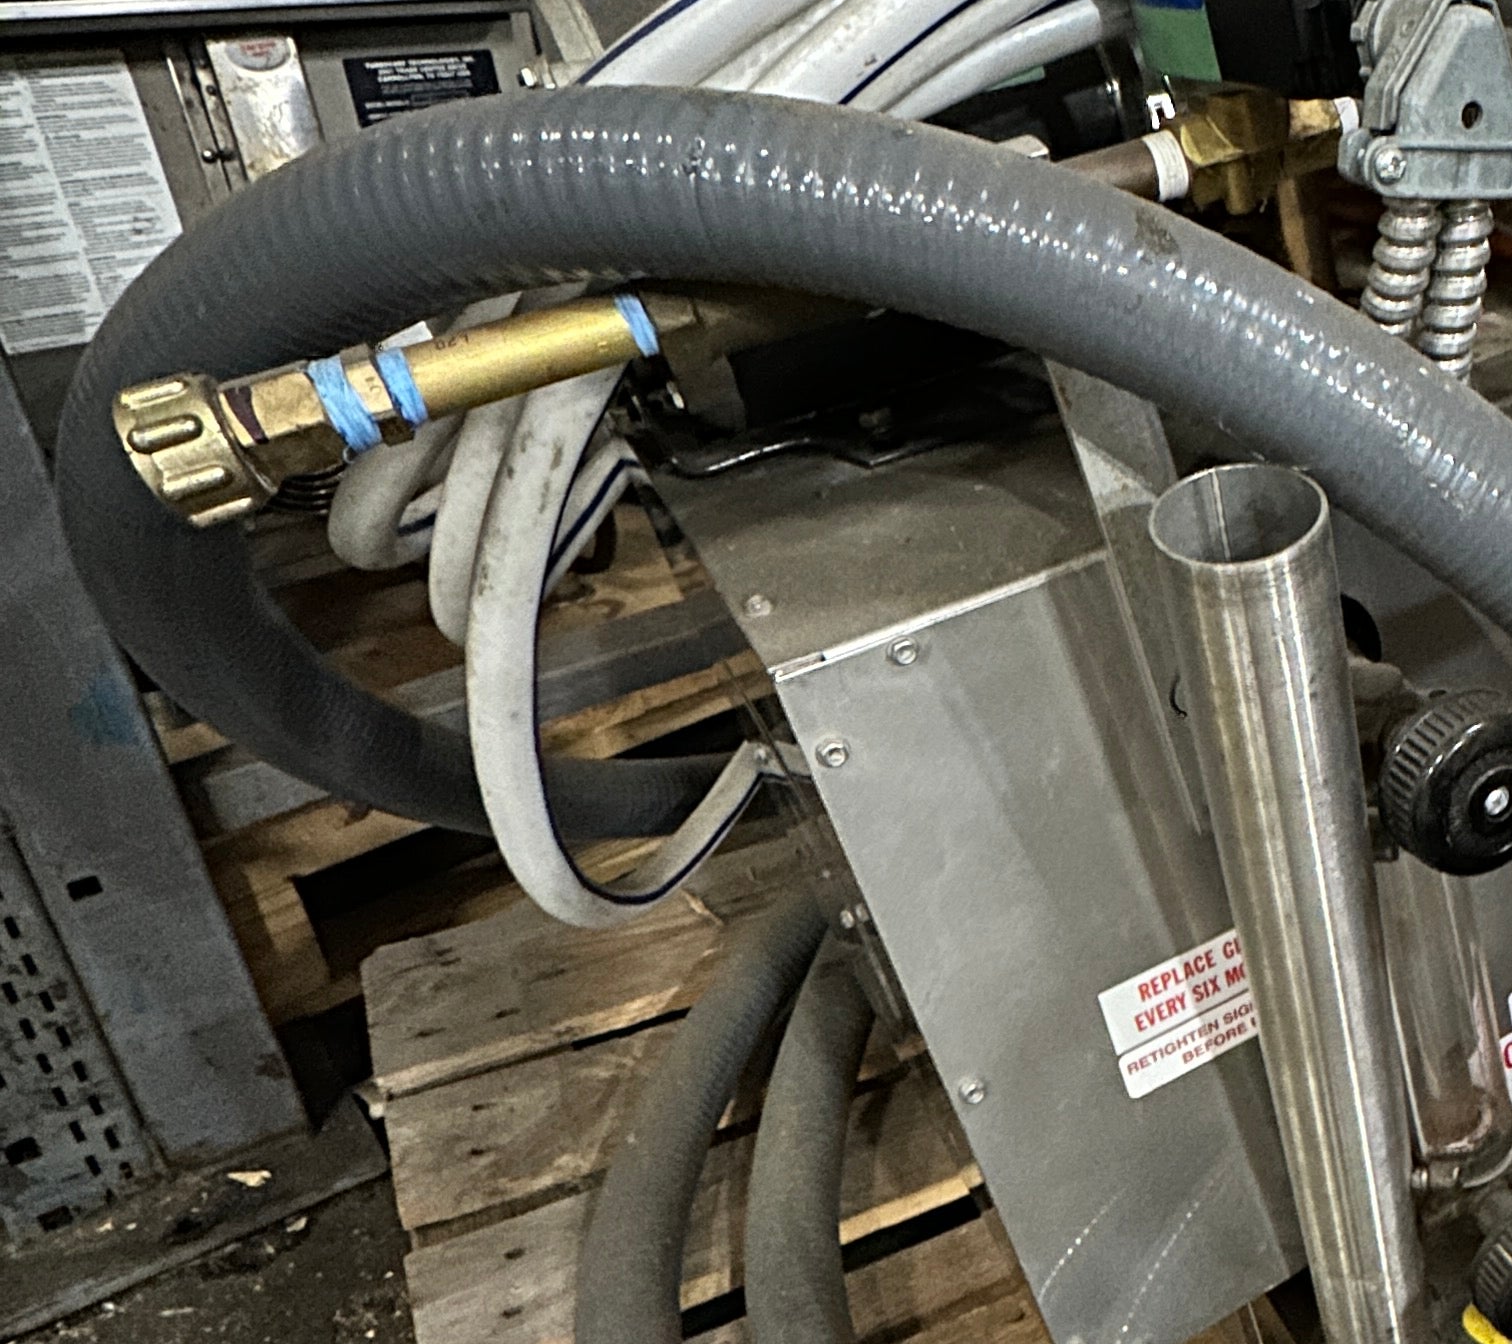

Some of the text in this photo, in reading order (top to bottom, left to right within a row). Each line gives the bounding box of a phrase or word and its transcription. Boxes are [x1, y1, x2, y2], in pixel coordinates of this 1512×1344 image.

[1137, 949, 1217, 1003] REPLACE
[1133, 991, 1188, 1033] EVERY
[1191, 975, 1221, 1003] SIX
[1126, 1019, 1220, 1076] RETIGHTEN
[1182, 1022, 1248, 1065] BEFORE
